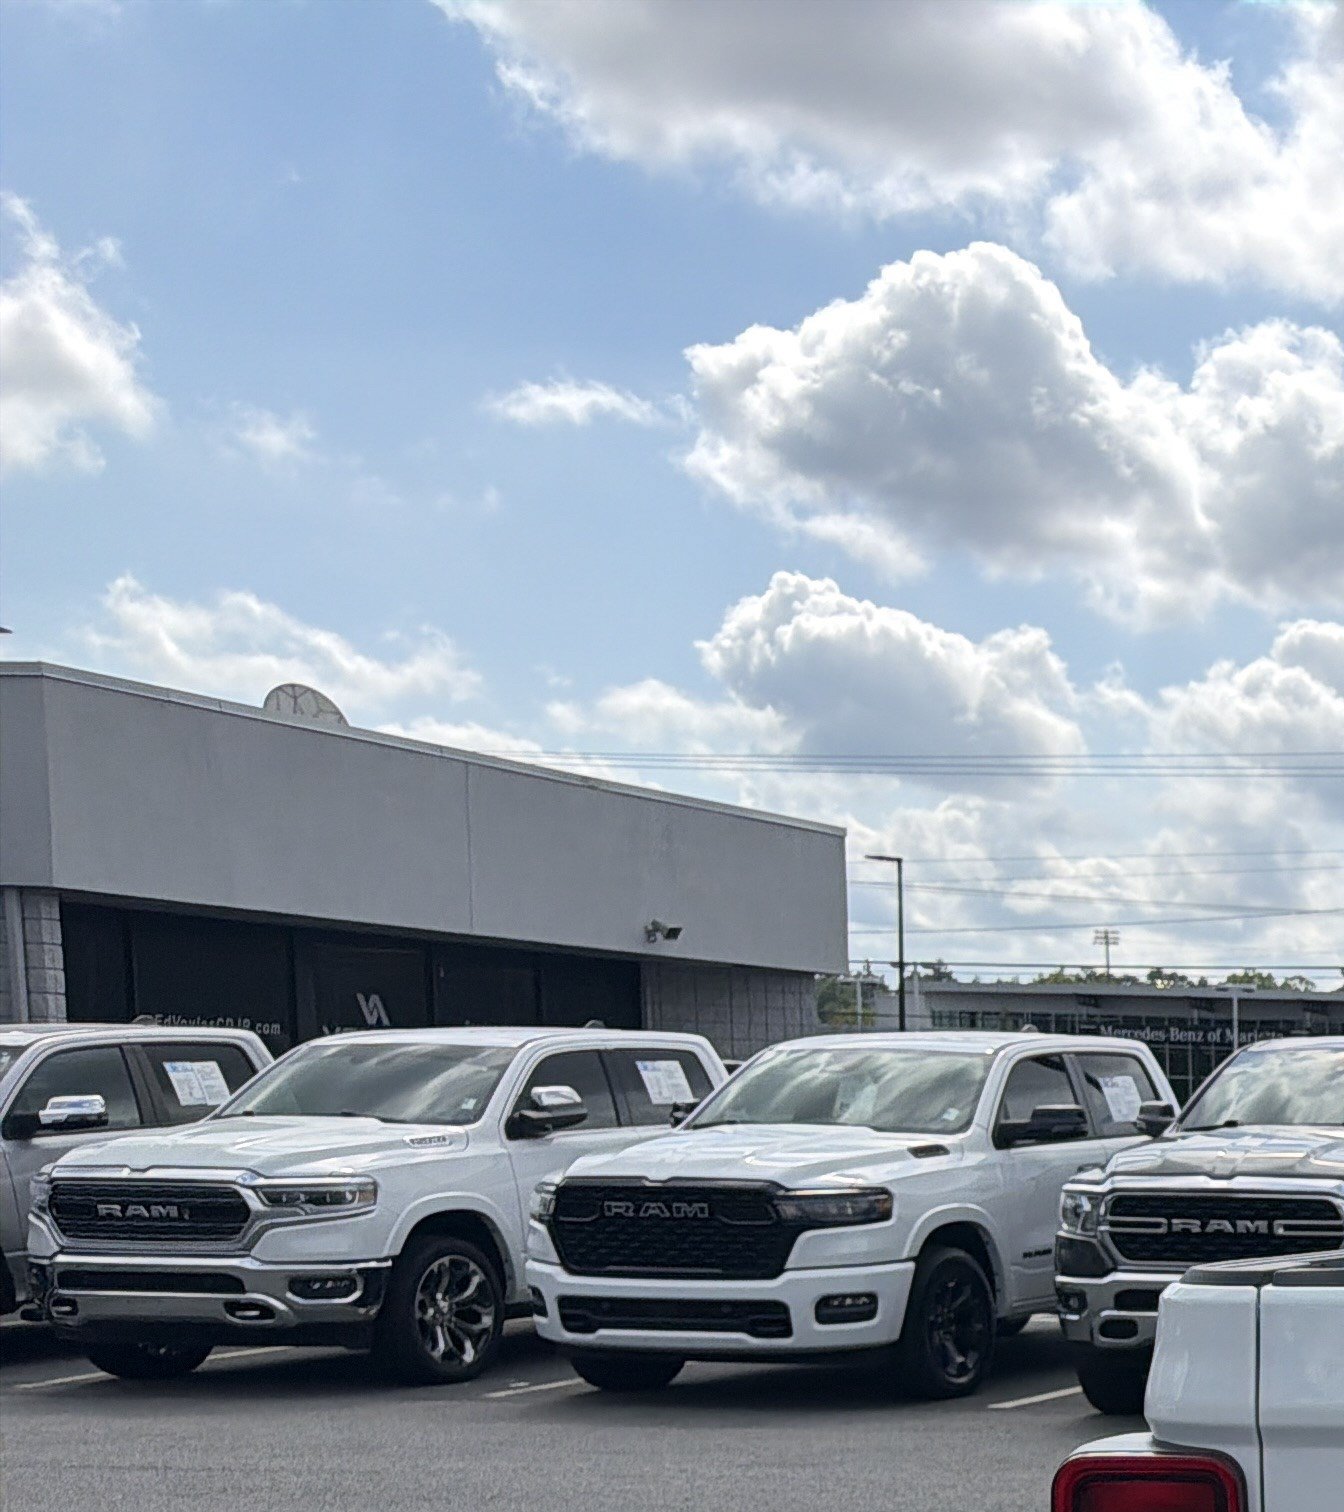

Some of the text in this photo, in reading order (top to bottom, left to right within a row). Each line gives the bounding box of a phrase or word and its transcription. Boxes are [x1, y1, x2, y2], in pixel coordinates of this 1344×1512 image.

[1207, 1027, 1222, 1043] of
[97, 1204, 179, 1218] RAM
[604, 1200, 709, 1218] RAM
[1171, 1218, 1268, 1233] RAM
